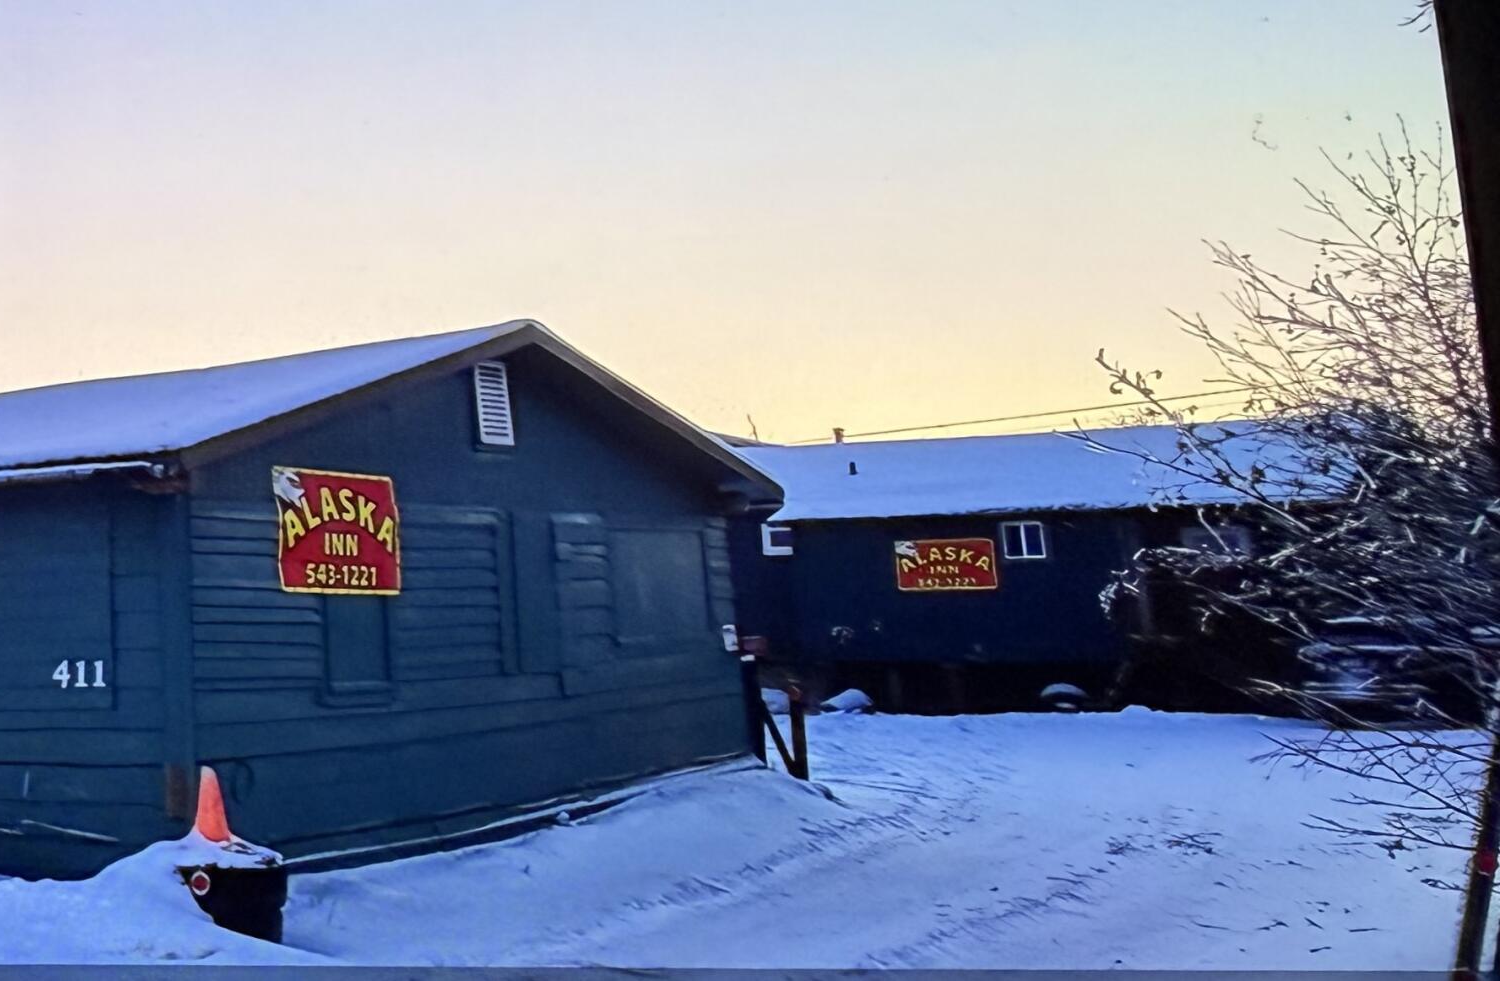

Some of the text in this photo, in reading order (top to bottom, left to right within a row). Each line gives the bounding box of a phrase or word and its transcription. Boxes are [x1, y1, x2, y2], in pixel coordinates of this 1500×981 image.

[284, 487, 394, 553] ALASKA
[324, 532, 358, 556] INN
[900, 547, 990, 573] ALASKA
[929, 565, 959, 575] INN
[304, 563, 377, 586] 543-1221
[51, 659, 106, 689] 411
